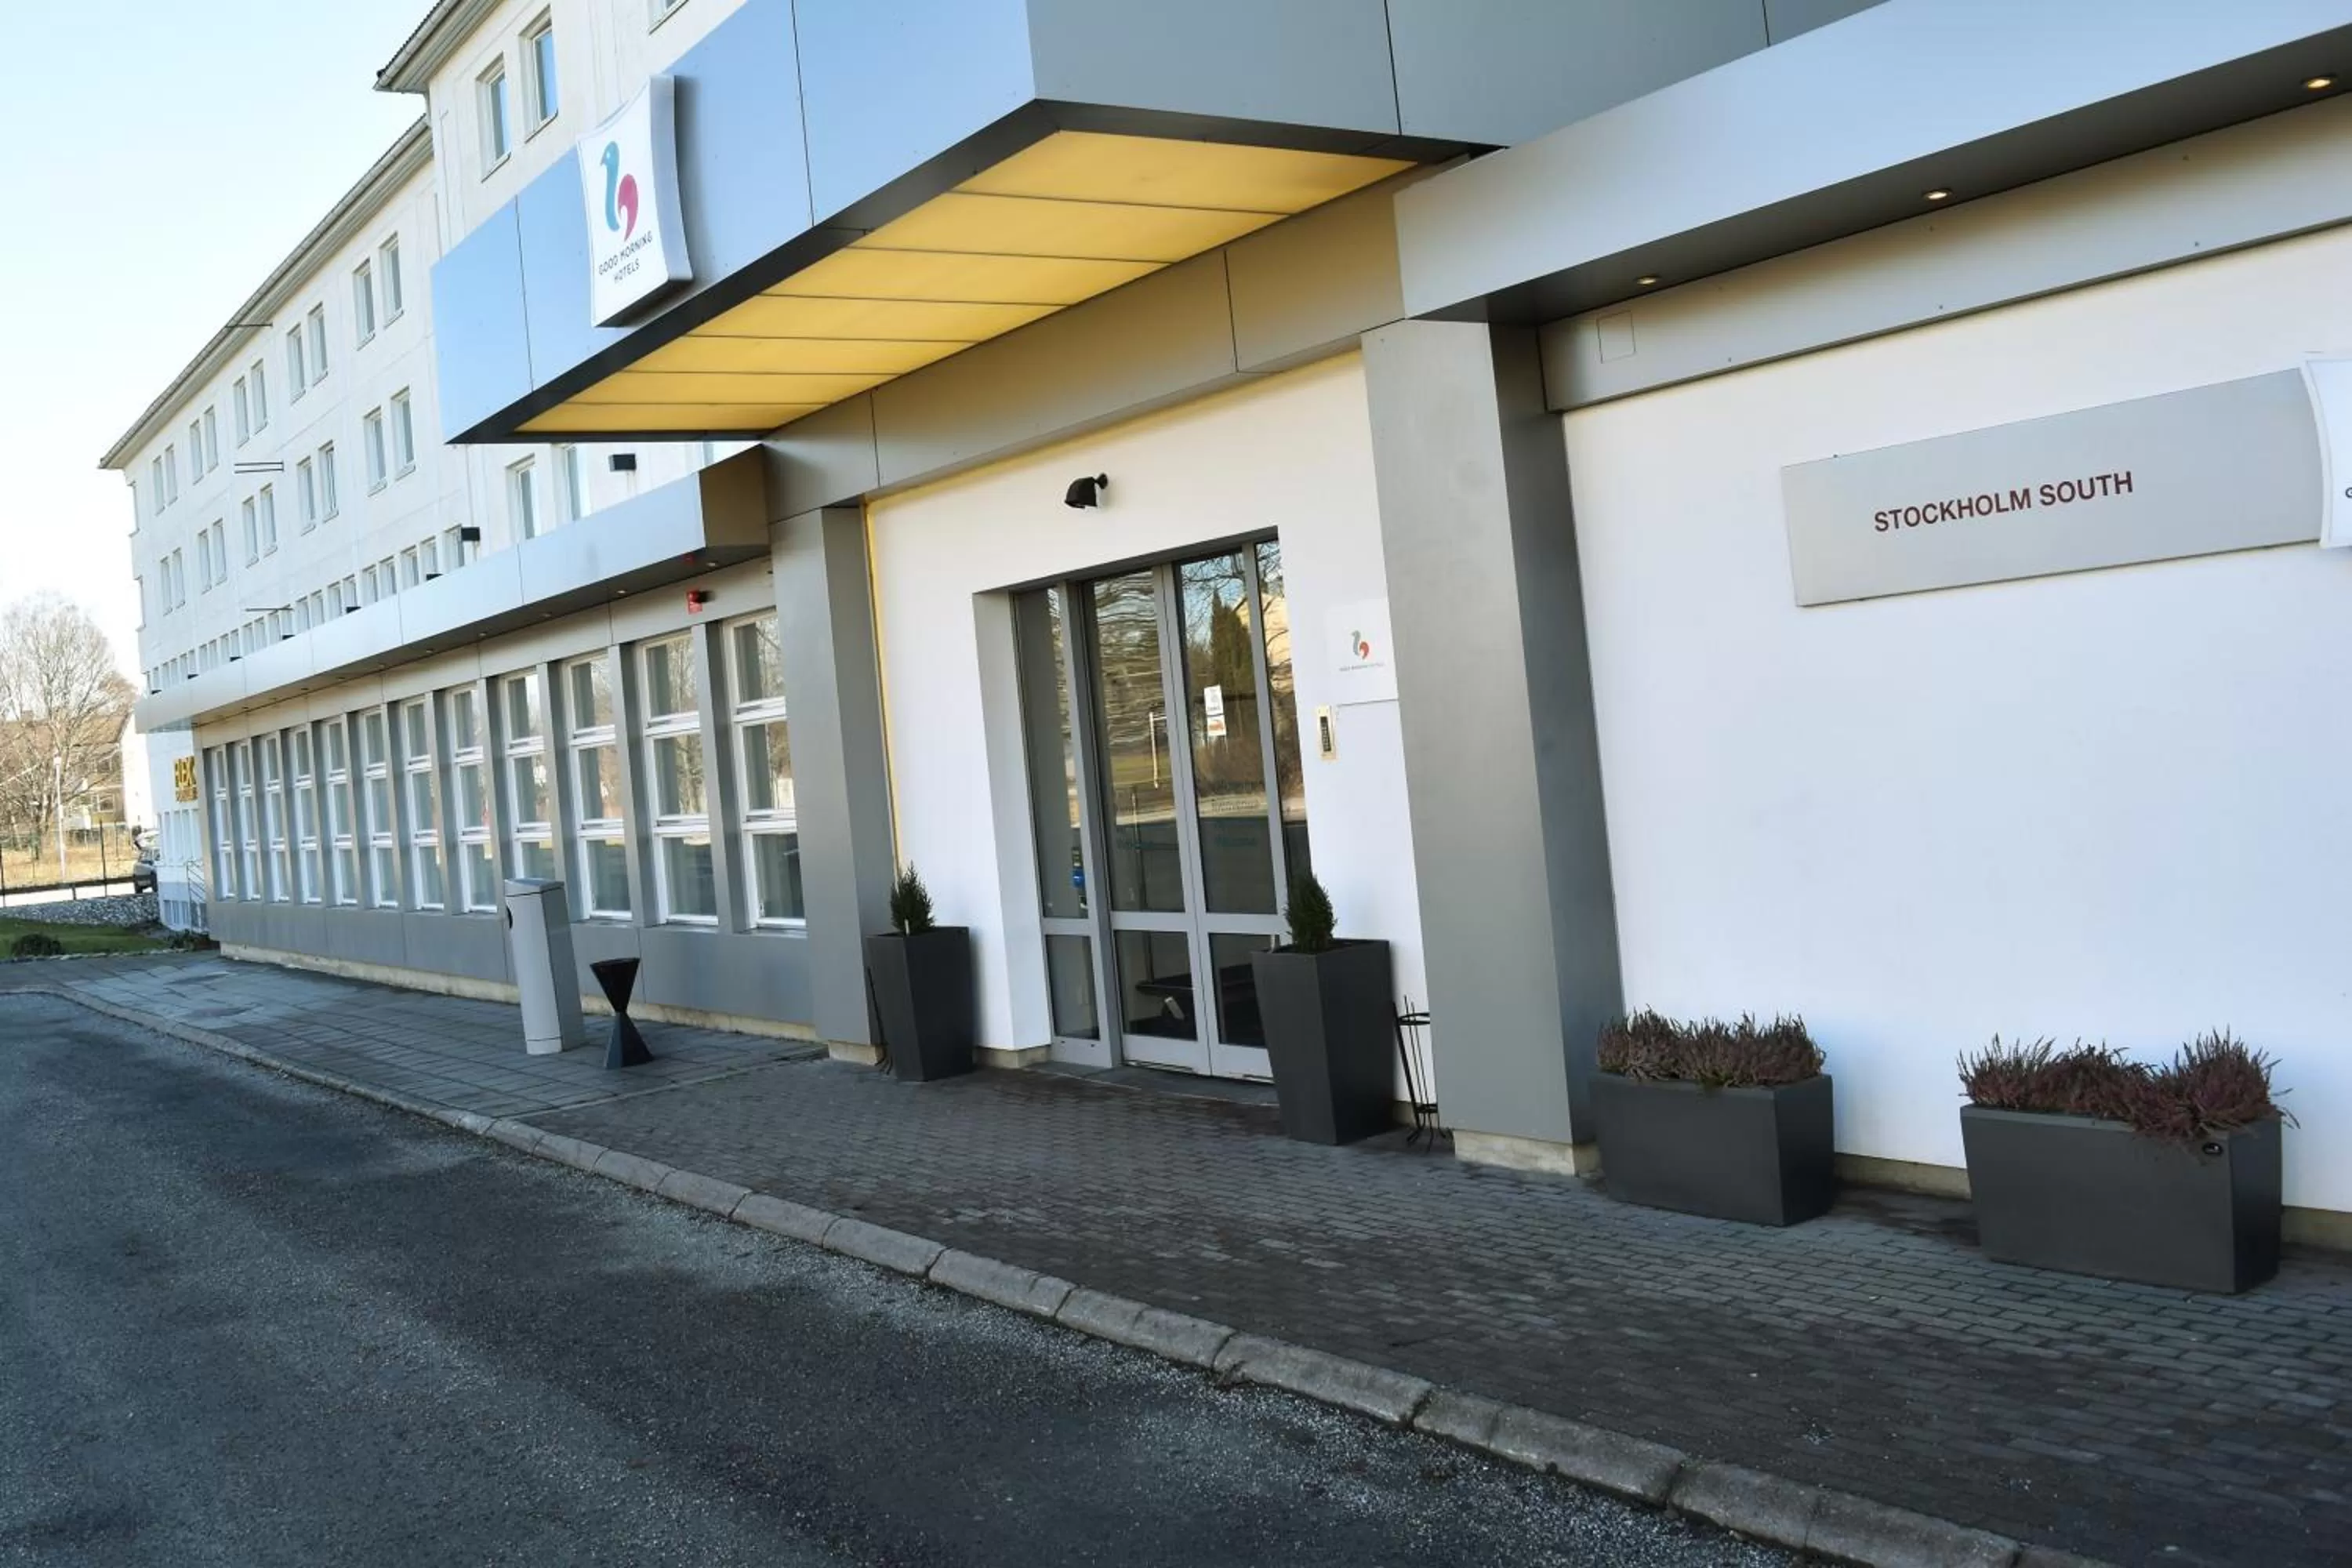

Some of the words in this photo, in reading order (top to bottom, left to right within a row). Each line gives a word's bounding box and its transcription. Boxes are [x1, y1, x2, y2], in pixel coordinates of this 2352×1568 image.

[598, 255, 619, 275] GOOD
[620, 230, 653, 261] MORNING
[614, 257, 641, 284] HOTELS
[1874, 488, 2032, 532] STOCKHOLM
[2039, 470, 2133, 506] SOUTH
